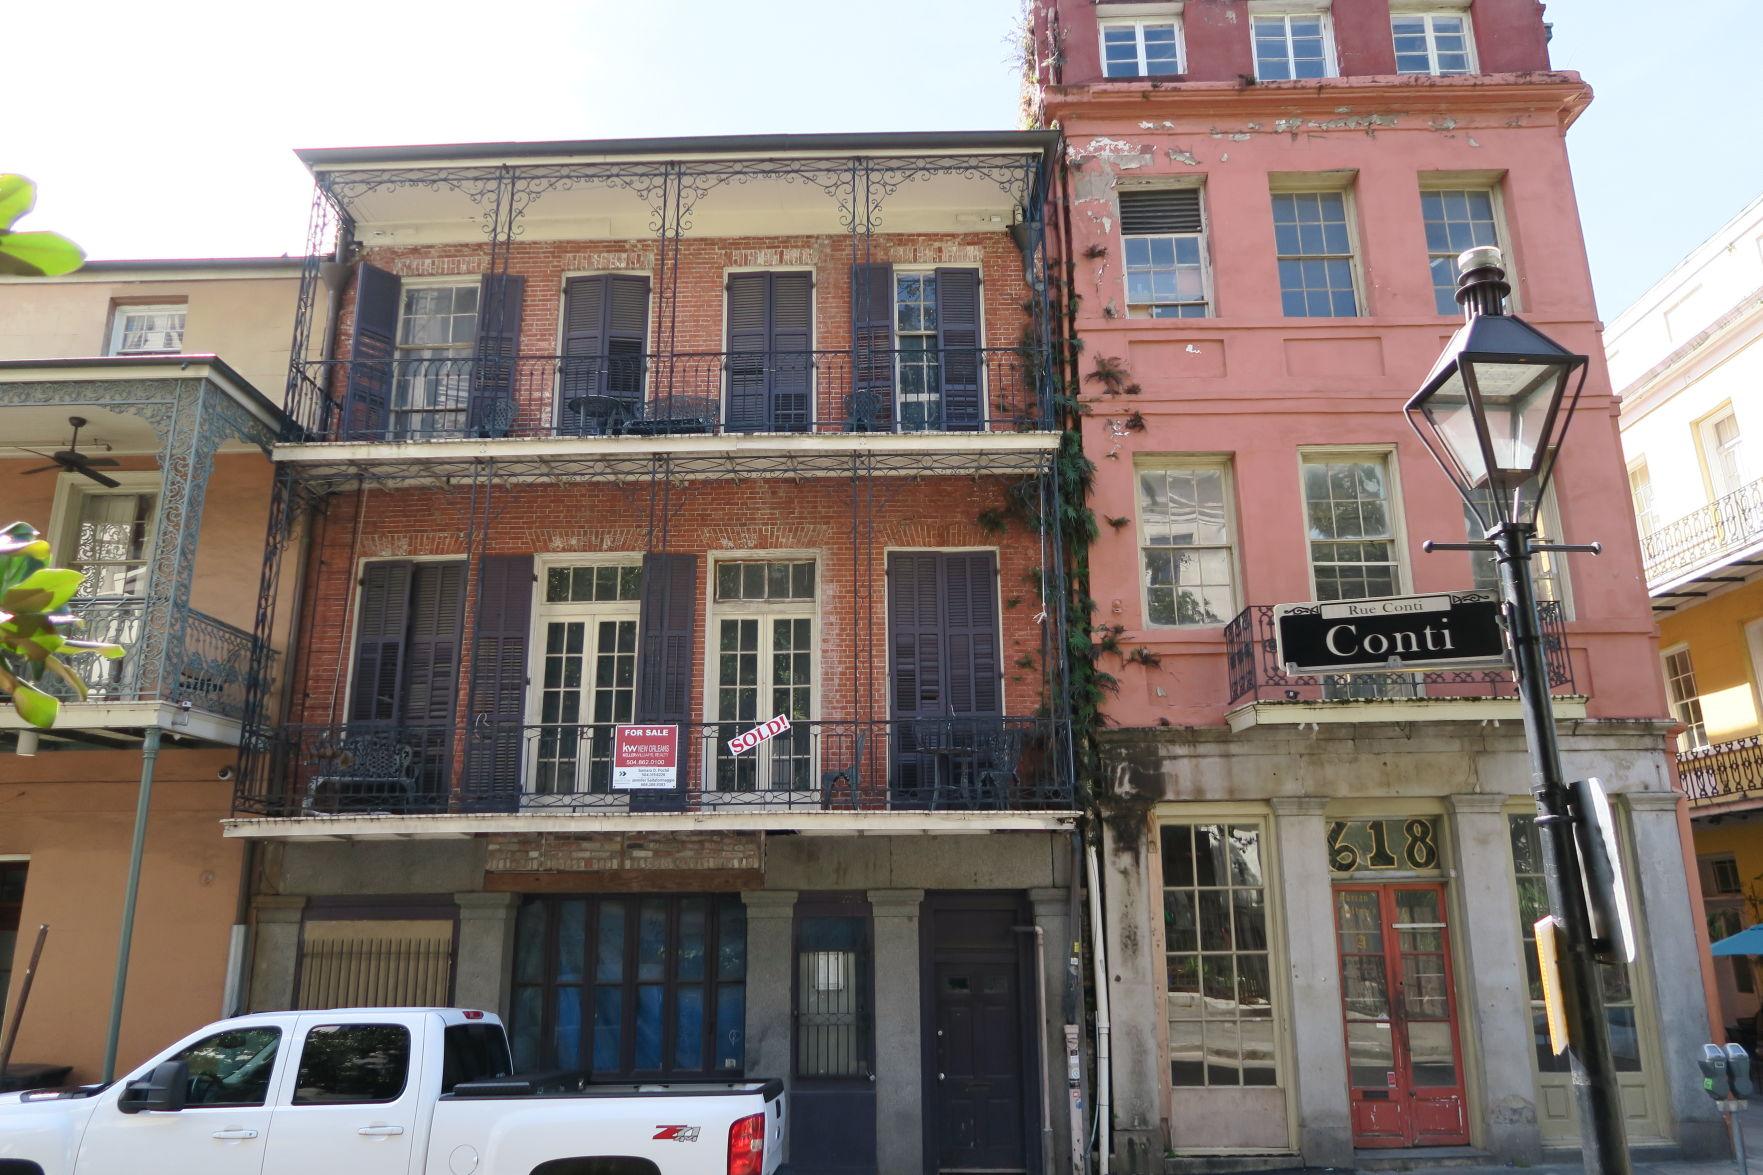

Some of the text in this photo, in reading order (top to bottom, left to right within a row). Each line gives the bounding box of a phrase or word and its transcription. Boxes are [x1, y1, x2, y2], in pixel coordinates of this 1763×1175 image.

[1348, 601, 1424, 615] Rue Conti
[1326, 617, 1455, 657] Conti
[731, 715, 789, 754] SOLD!
[1327, 819, 1437, 872] 618
